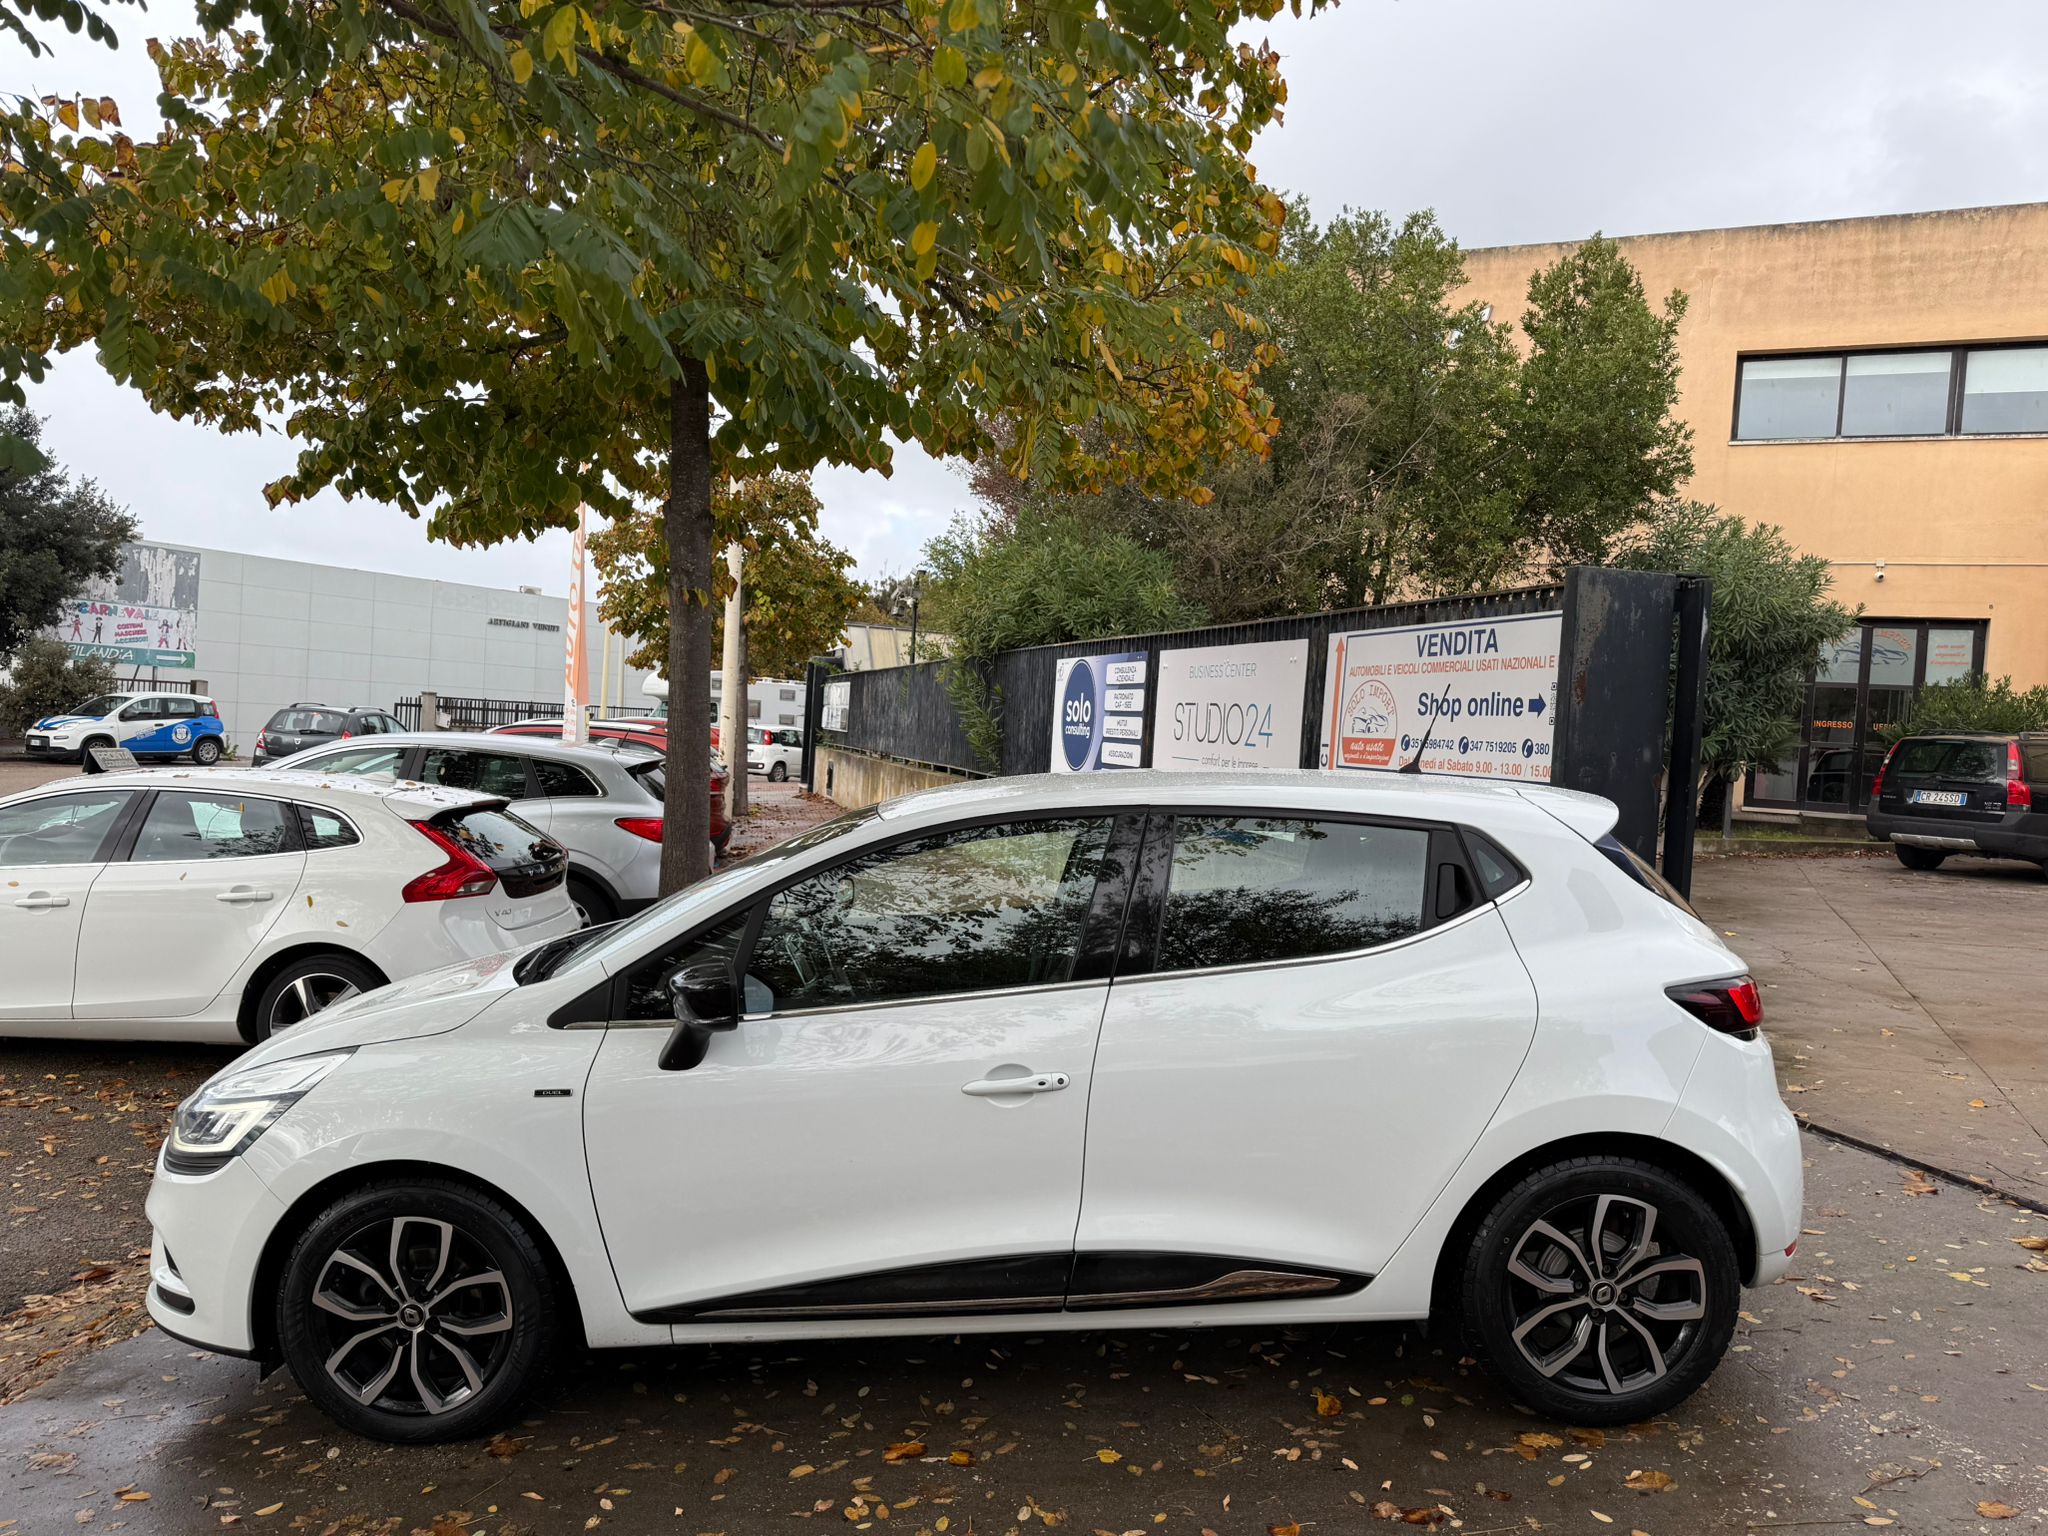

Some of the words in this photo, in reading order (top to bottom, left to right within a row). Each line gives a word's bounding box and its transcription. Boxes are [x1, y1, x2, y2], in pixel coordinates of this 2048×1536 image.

[1417, 628, 1499, 658] VENDITA
[1189, 664, 1224, 678] BUSINESS
[1225, 662, 1257, 677] CENTER
[1350, 664, 1386, 677] AUTOMOBILI
[1388, 664, 1392, 675] E
[1393, 662, 1420, 675] VEICOLI
[1421, 660, 1474, 674] COMMERCIALI
[1476, 658, 1499, 671] USATI
[1501, 656, 1547, 670] NAZIONALI
[1549, 655, 1555, 668] E
[1065, 692, 1091, 723] solo
[1347, 688, 1365, 717] SOLO
[1369, 685, 1395, 717] IMPORT
[1417, 692, 1462, 723] Shop
[1468, 691, 1524, 717] online
[1065, 723, 1091, 739] consulting
[1174, 703, 1273, 748] STUDIO24
[1813, 720, 1854, 729] INGRESSO
[1469, 741, 1484, 751] 347
[1485, 741, 1517, 753] 7519205
[1534, 743, 1550, 755] 380
[1437, 759, 1445, 770] al
[1446, 758, 1474, 772] Sabato
[1475, 761, 1493, 774] 9.00
[1500, 763, 1522, 776] 13.00
[1920, 791, 1931, 801] CR
